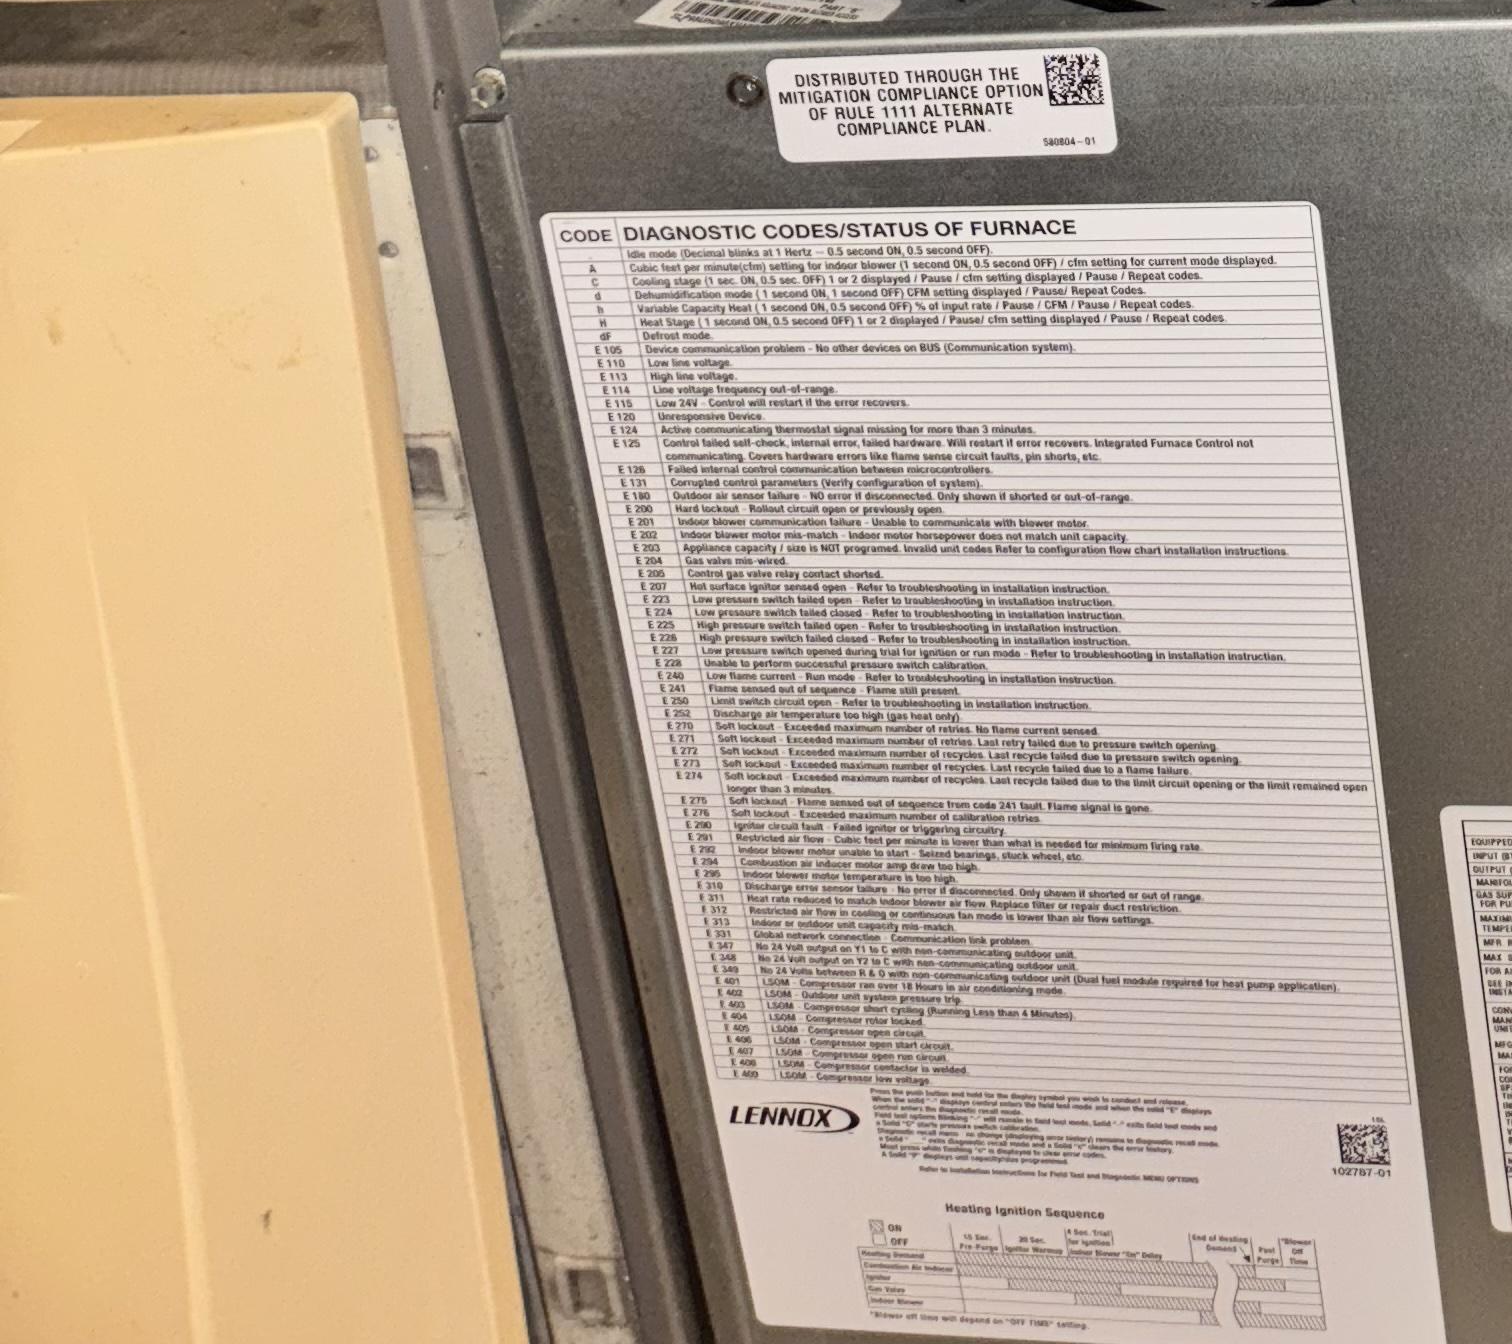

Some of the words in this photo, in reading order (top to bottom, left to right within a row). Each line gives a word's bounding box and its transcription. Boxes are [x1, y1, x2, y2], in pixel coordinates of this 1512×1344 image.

[795, 71, 899, 88] DISTRIBUTED
[904, 69, 982, 84] THROUGH
[988, 67, 1020, 81] THE
[778, 88, 871, 105] MITIGATION
[877, 85, 979, 102] COMPLIANCE
[985, 83, 1044, 98] OPTION
[809, 107, 828, 121] OF
[835, 105, 875, 120] RULE
[882, 103, 916, 118] 1111
[923, 101, 1013, 117] ALTERNATE
[837, 120, 938, 137] COMPLIANCE
[560, 229, 612, 242] CODE
[624, 225, 756, 241] DIAGNOSTIC
[762, 222, 929, 240] CODES/STATUS
[935, 222, 963, 236] OF
[970, 220, 1077, 235] FURNACE
[643, 331, 679, 341] Defrost
[604, 345, 623, 355] 105
[645, 344, 679, 354] Device
[682, 344, 761, 354] communication
[763, 344, 805, 355] problem
[832, 343, 858, 353] other
[862, 343, 900, 352] devices
[920, 342, 940, 352] BUS
[944, 342, 1029, 354] (Communication
[648, 358, 669, 367] Low
[672, 358, 690, 367] line
[658, 412, 726, 422] Unresponsive
[730, 1105, 833, 1128] LENNOX
[945, 1203, 992, 1216] Heating
[996, 1205, 1042, 1218] Ignition
[1046, 1208, 1105, 1221] Sequence
